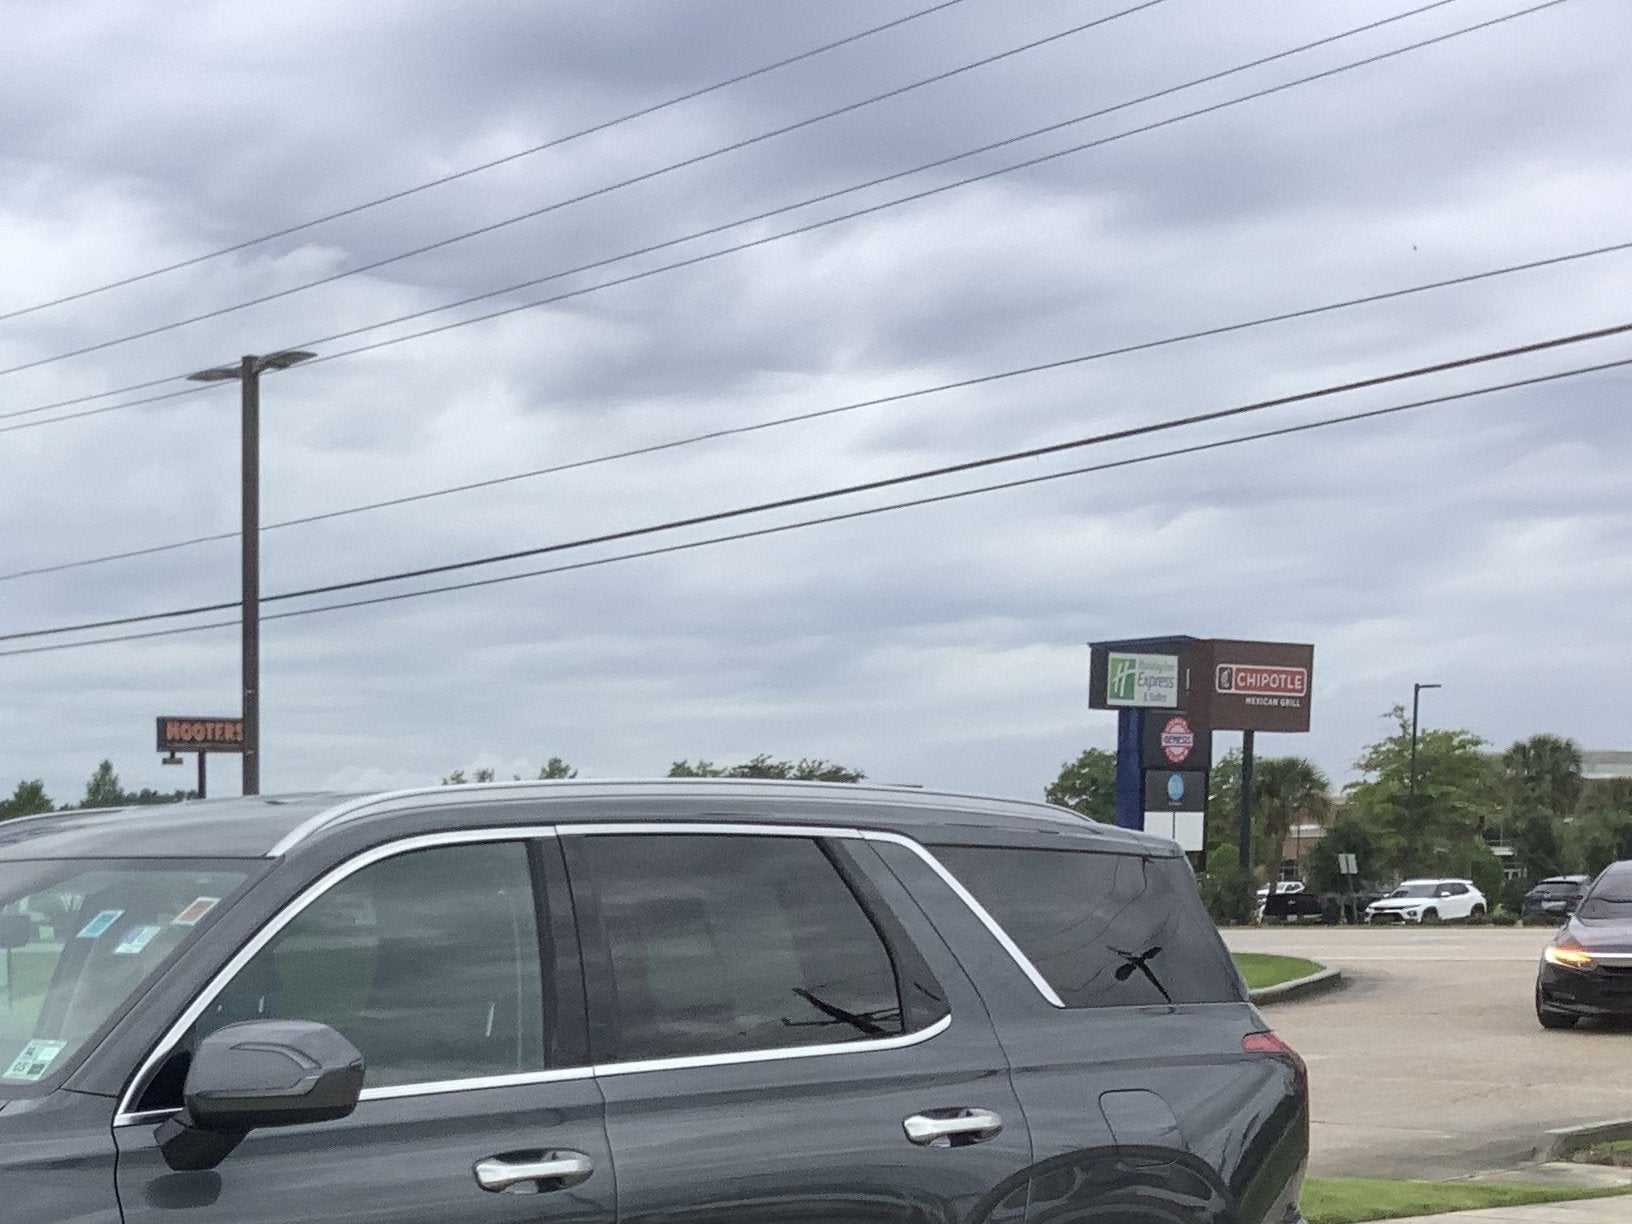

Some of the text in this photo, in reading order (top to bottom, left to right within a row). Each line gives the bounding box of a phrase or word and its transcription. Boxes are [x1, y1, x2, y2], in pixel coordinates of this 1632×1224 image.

[1138, 671, 1174, 691] Express
[1237, 672, 1302, 689] CHIPOTLE
[1245, 697, 1300, 707] MEXICAN GRILL
